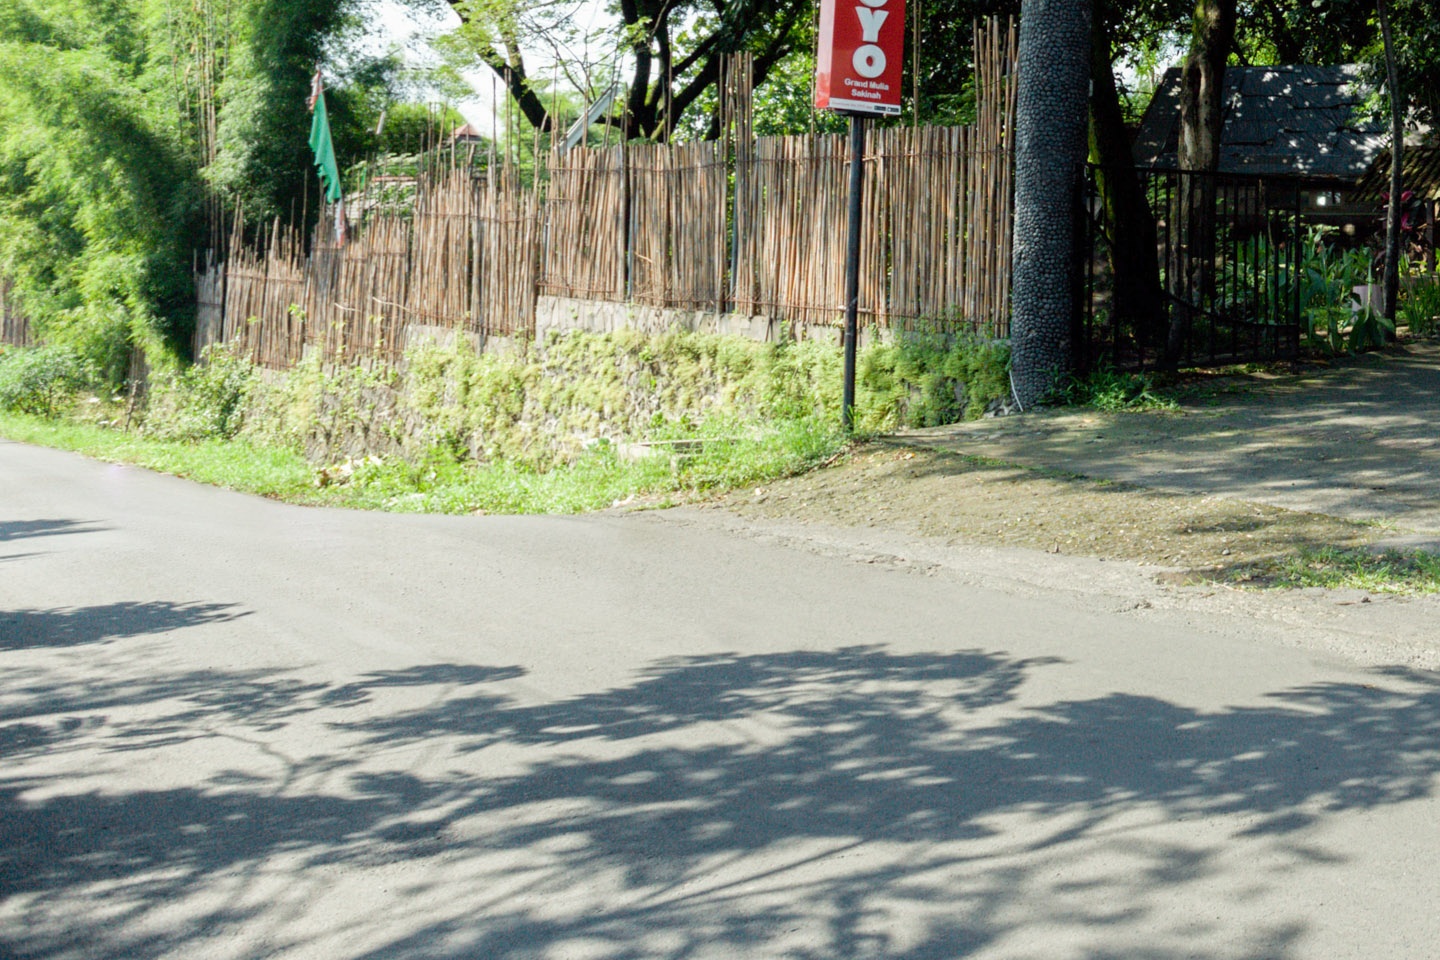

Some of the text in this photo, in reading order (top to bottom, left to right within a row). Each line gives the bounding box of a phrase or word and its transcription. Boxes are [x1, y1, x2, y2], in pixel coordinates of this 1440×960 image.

[844, 77, 889, 91] Grand Mulia
[851, 88, 882, 100] Sakinah
